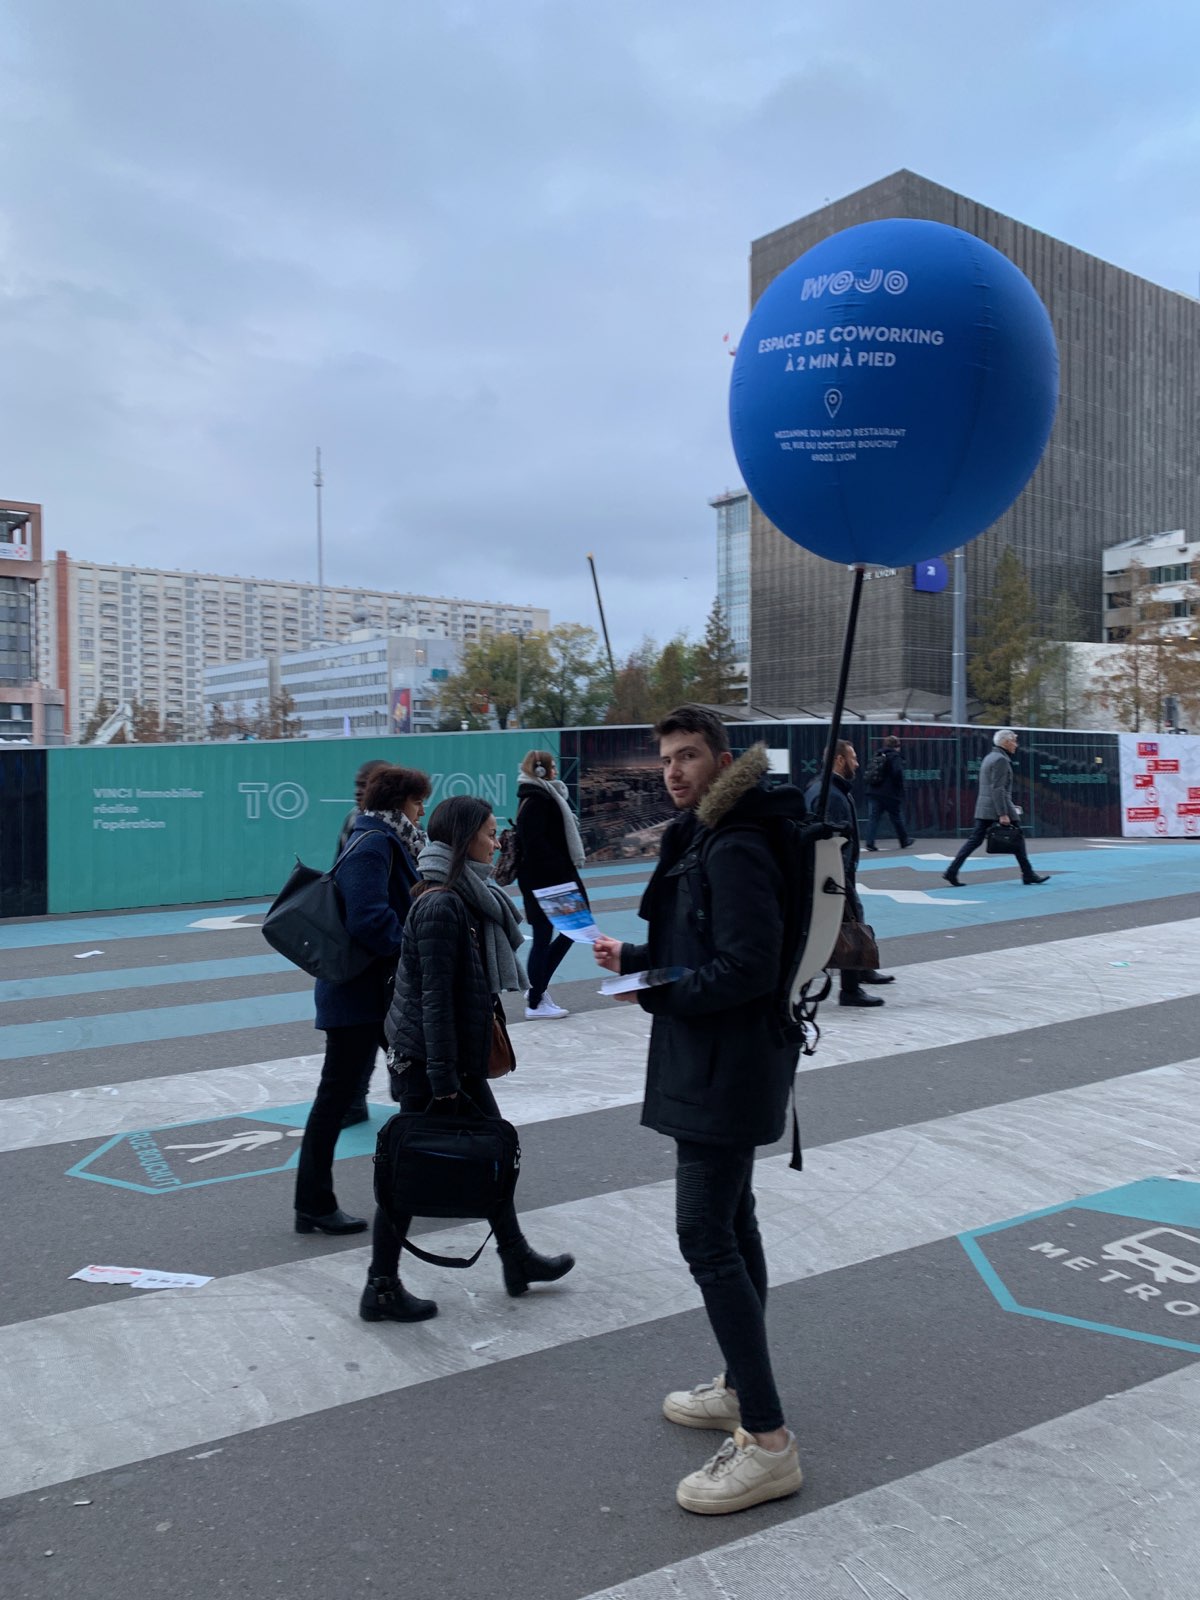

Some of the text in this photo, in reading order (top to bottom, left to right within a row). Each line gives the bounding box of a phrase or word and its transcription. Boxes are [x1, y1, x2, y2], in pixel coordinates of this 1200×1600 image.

[801, 269, 908, 301] WOJO
[758, 326, 944, 353] ESPACE DE COWORKING
[784, 348, 896, 371] À 2 MIN À PIED
[853, 428, 906, 437] RESTAURANT
[817, 441, 856, 449] DOCTEUR
[857, 440, 898, 448] BOUCHUT
[93, 788, 205, 798] VINCI Immobilier
[238, 781, 310, 819] TO
[93, 803, 140, 814] réalise
[93, 818, 166, 831] l'opération
[1028, 1241, 1200, 1316] METRO
